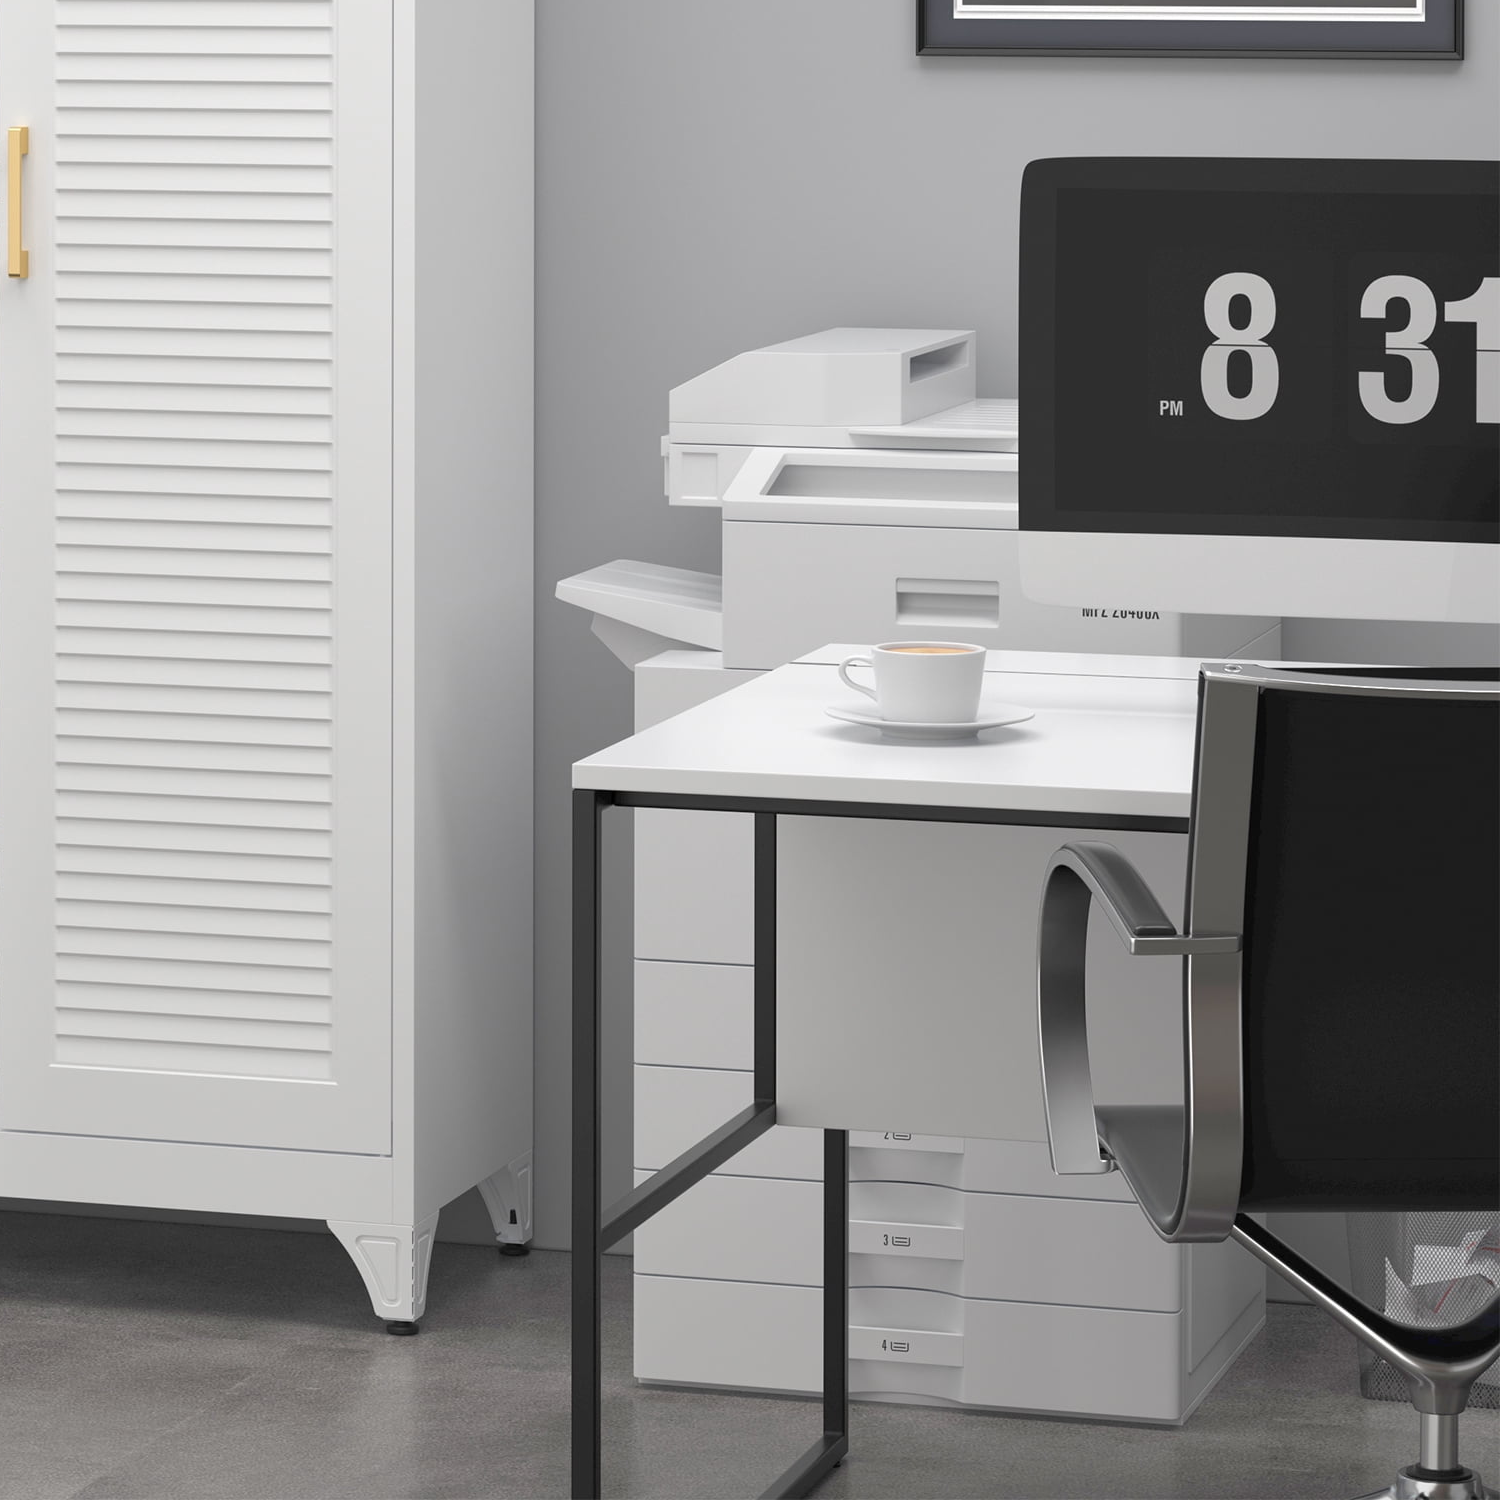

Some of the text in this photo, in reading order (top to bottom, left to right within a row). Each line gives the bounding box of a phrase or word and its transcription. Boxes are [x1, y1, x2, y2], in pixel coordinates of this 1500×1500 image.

[1200, 272, 1500, 425] 8 31
[1159, 400, 1184, 417] PM
[883, 1234, 888, 1246] 3
[882, 1339, 887, 1351] 4
